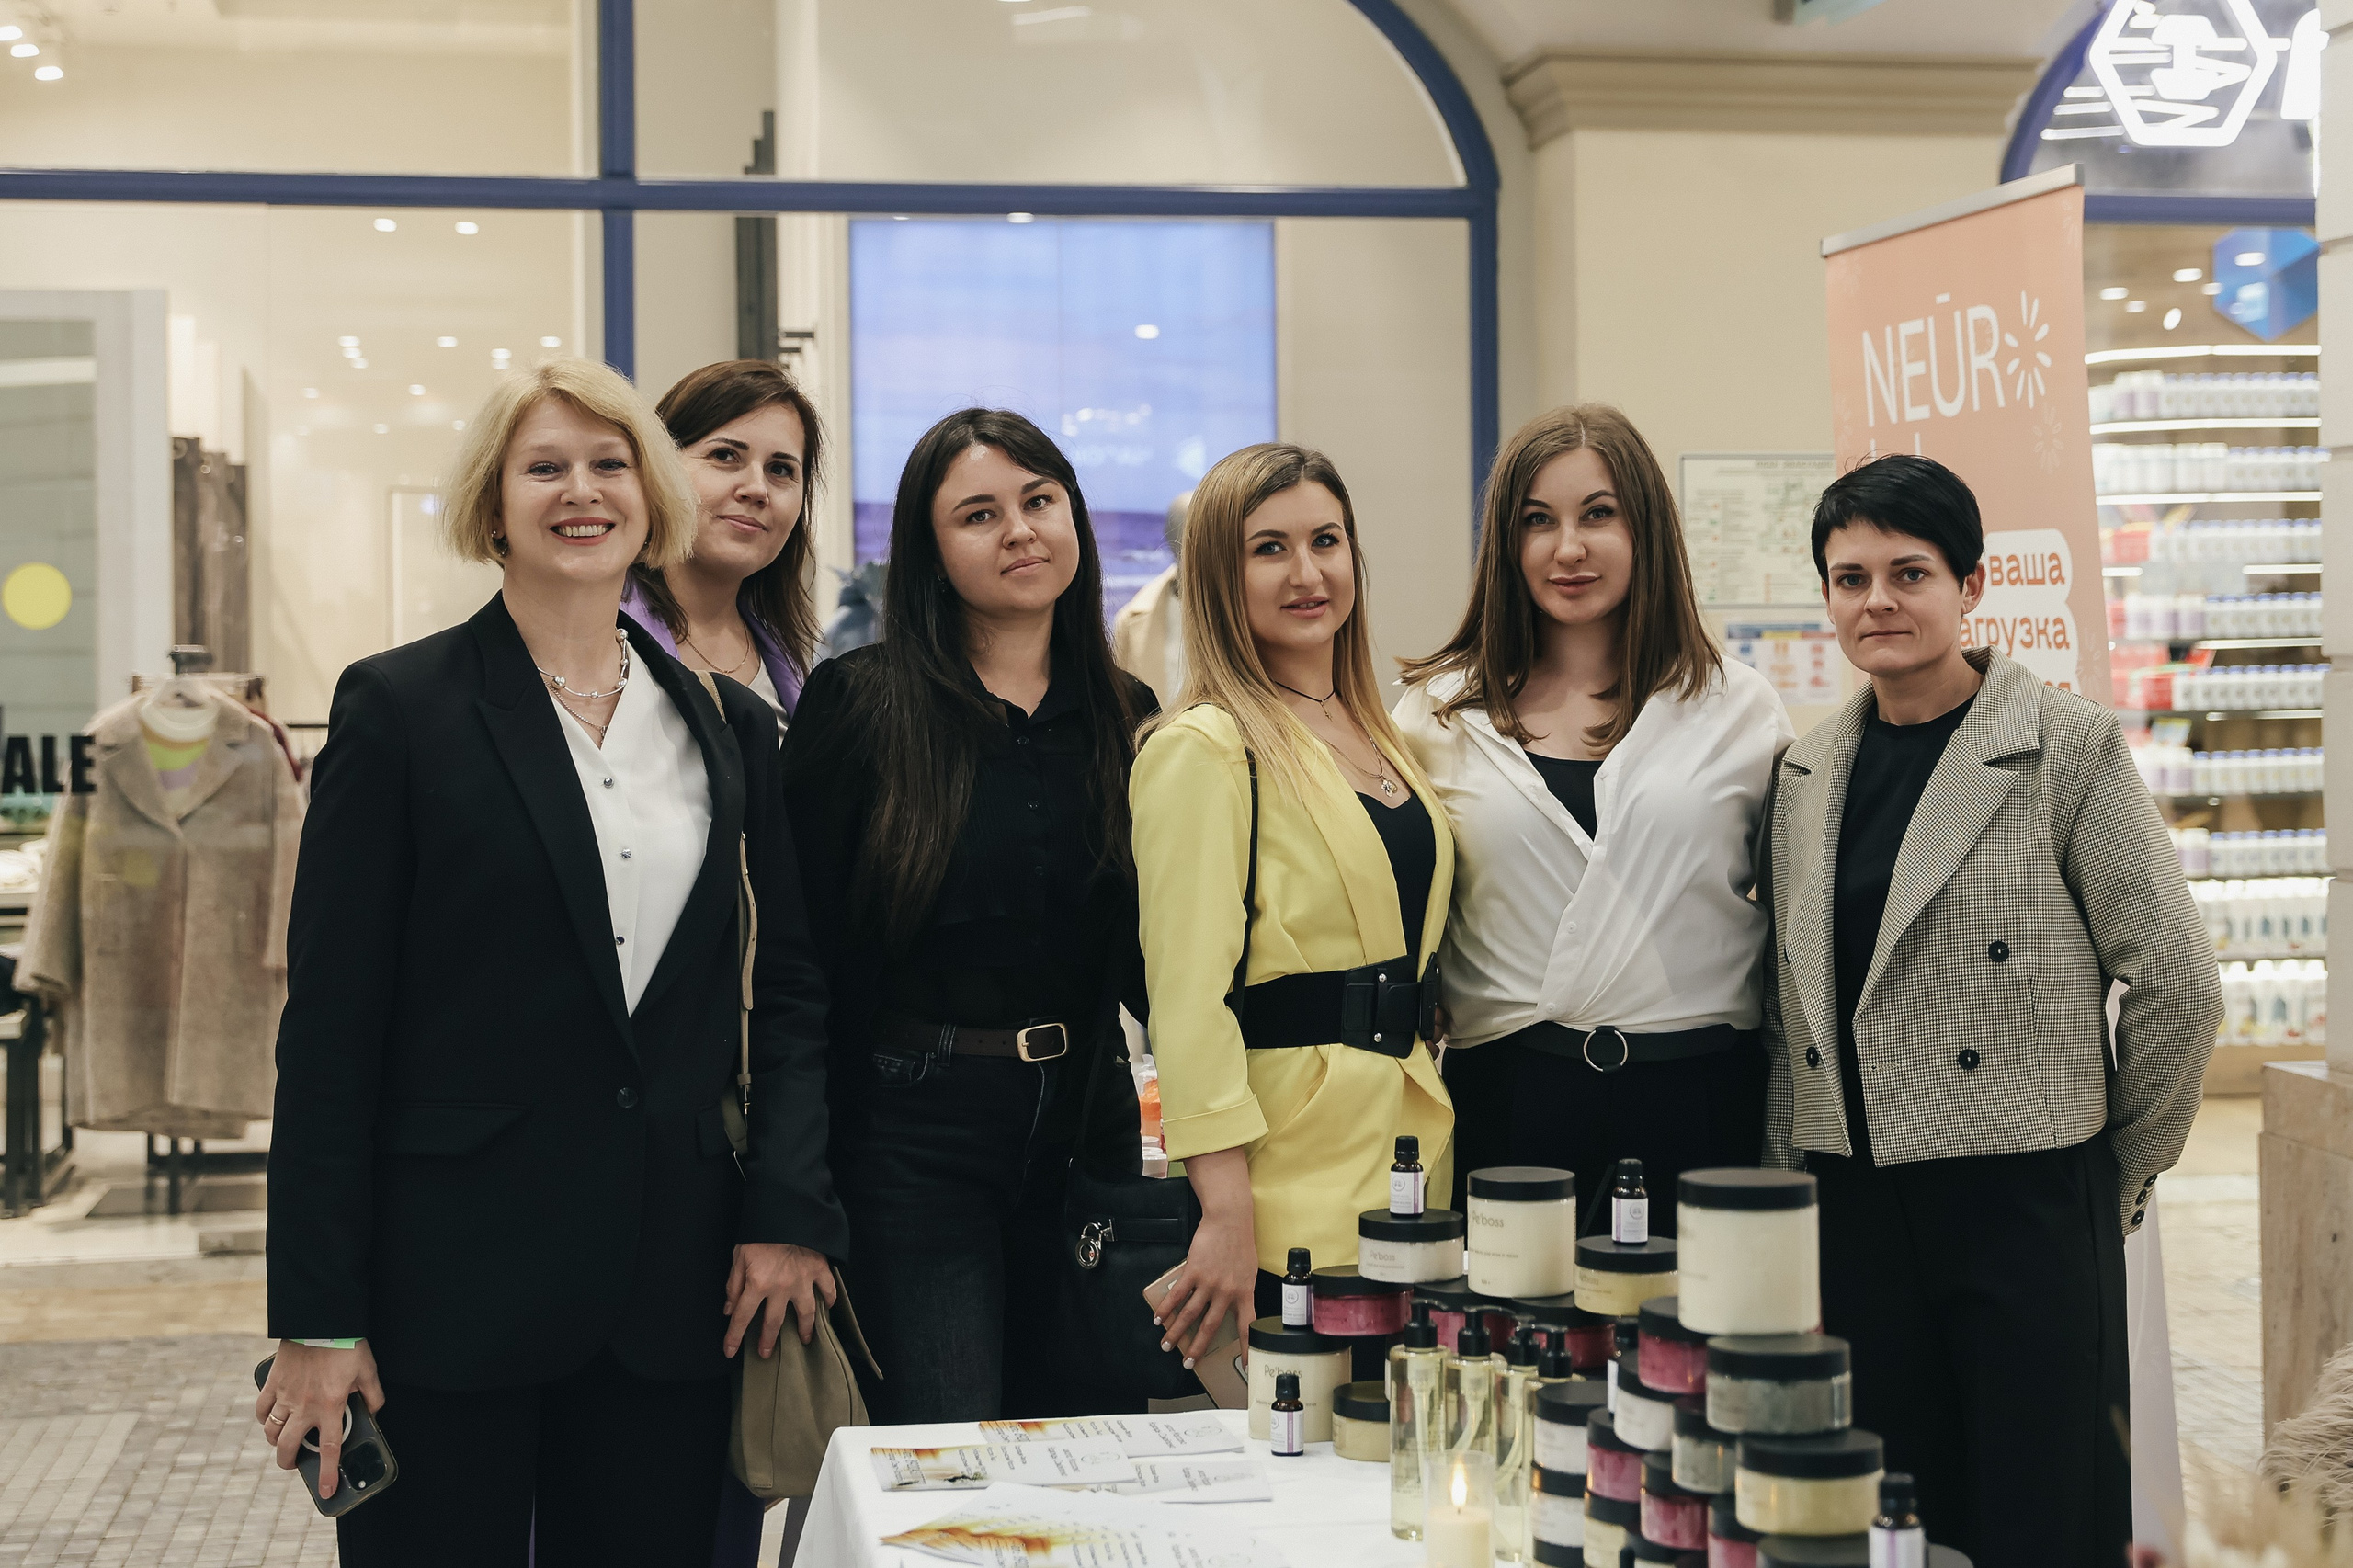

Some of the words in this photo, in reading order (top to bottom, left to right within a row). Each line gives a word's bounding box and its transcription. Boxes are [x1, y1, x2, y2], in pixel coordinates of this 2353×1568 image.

[1989, 552, 2065, 586] ваша
[1960, 617, 2071, 658] агрузка
[0, 735, 97, 793] ALE
